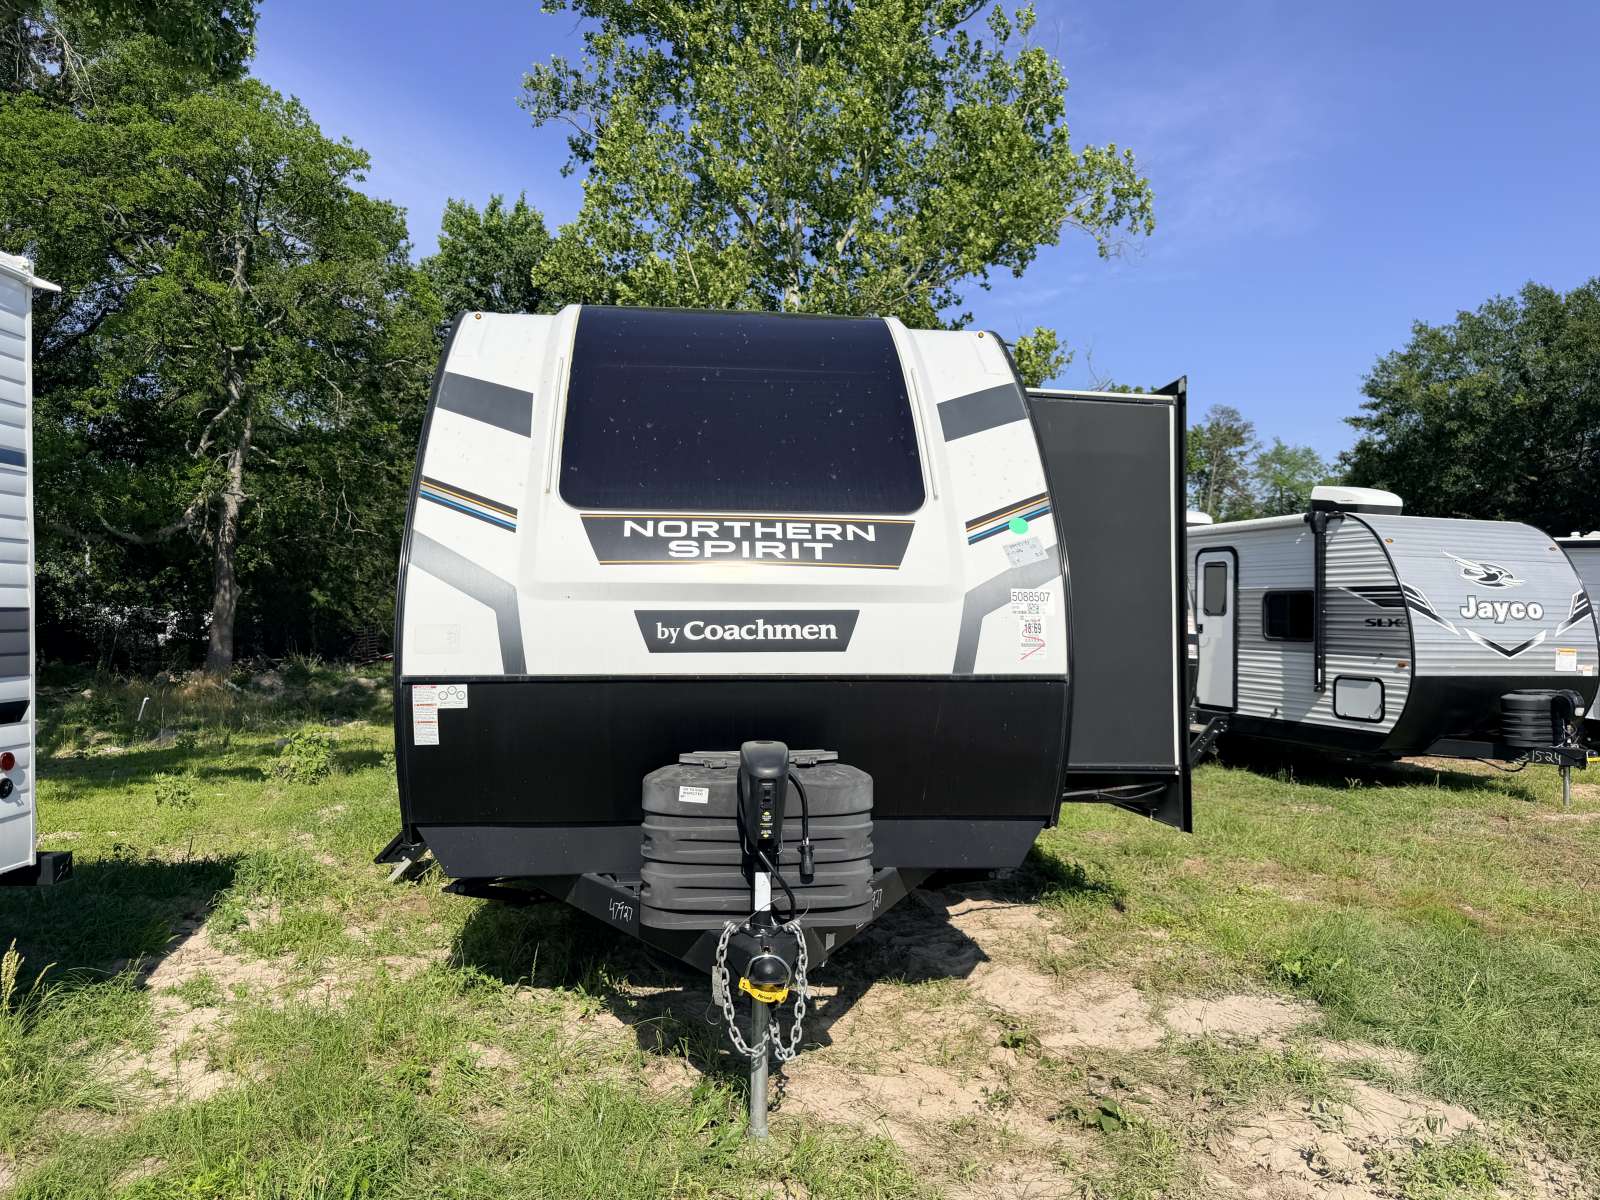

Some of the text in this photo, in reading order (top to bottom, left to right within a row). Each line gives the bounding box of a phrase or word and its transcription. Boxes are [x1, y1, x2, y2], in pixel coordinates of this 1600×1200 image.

[623, 520, 876, 542] NORTHERN
[668, 540, 834, 560] SPIRIT
[1459, 595, 1545, 624] Jayco
[655, 619, 838, 644] by Coachmen
